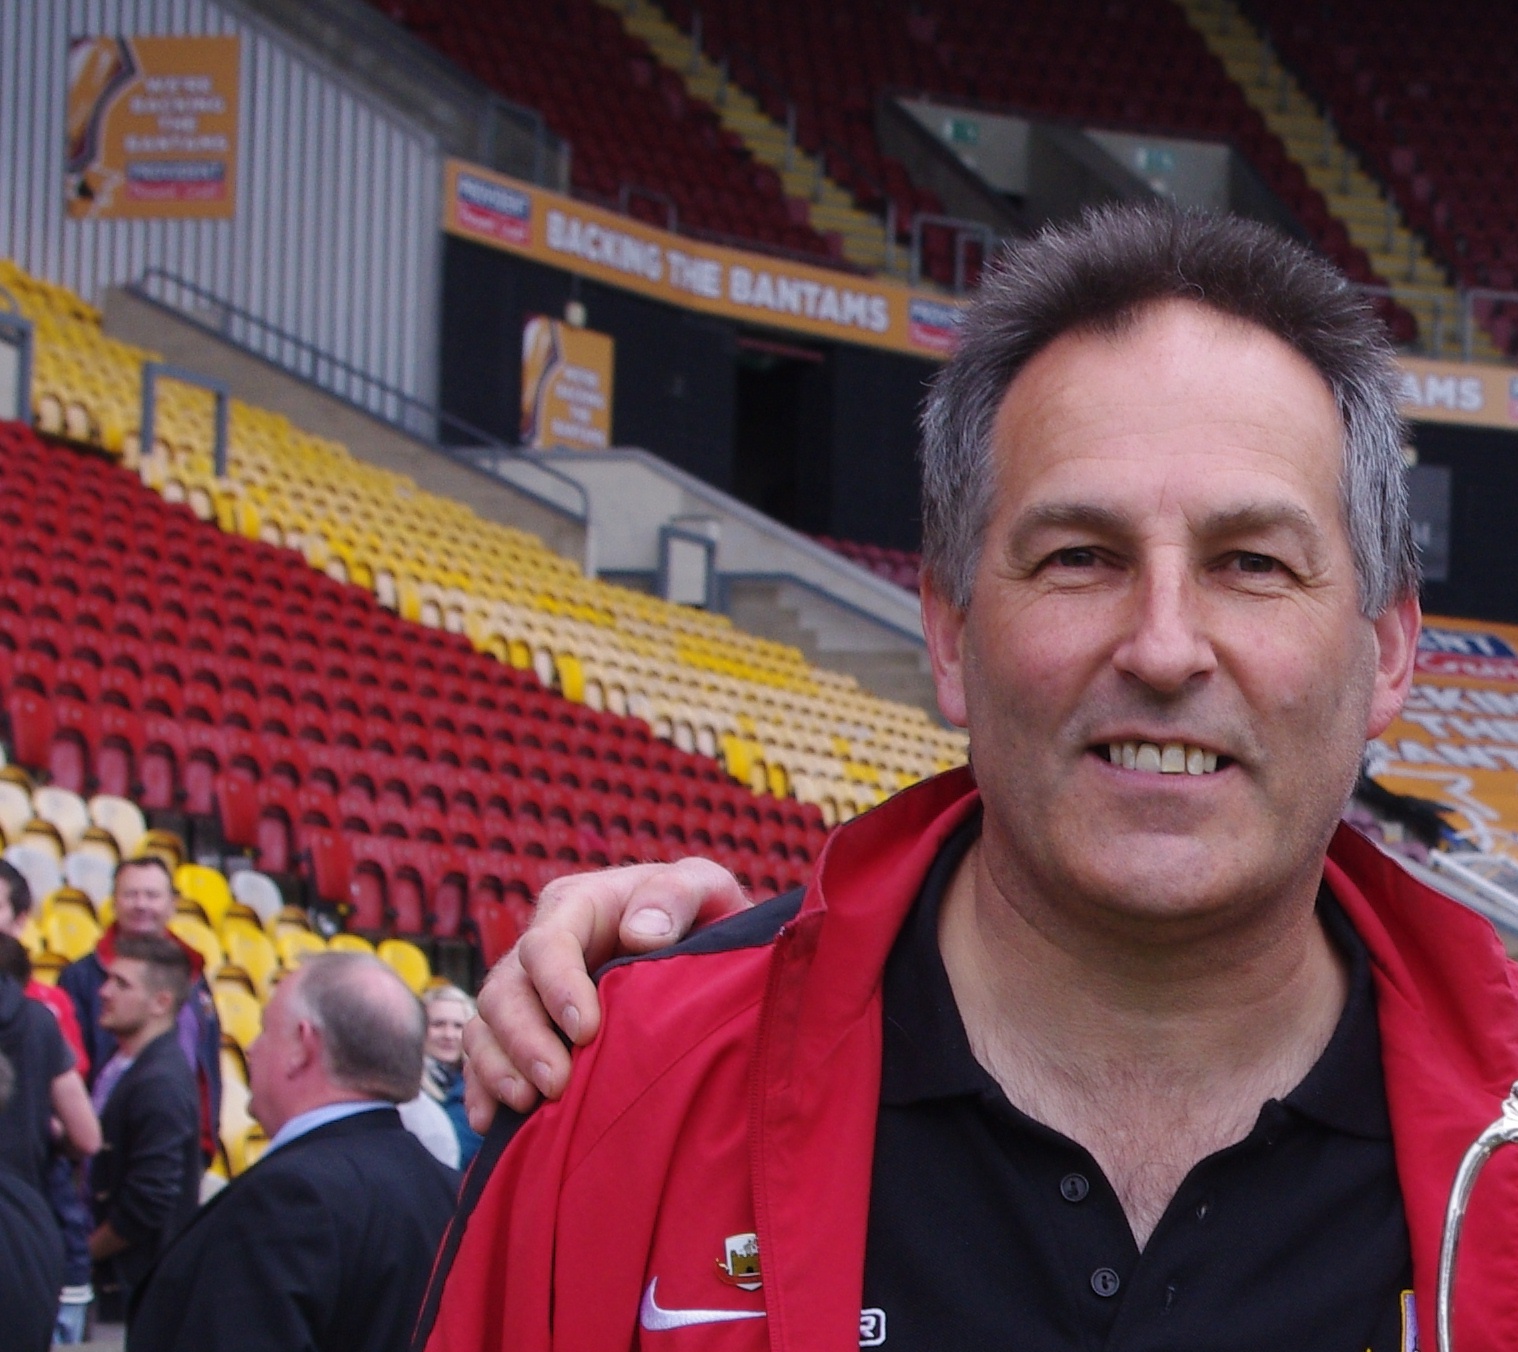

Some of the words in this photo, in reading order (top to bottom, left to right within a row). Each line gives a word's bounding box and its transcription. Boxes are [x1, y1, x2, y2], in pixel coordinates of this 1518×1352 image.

[545, 210, 663, 283] BACKING
[665, 249, 722, 299] THE
[728, 265, 889, 333] BANTAMS
